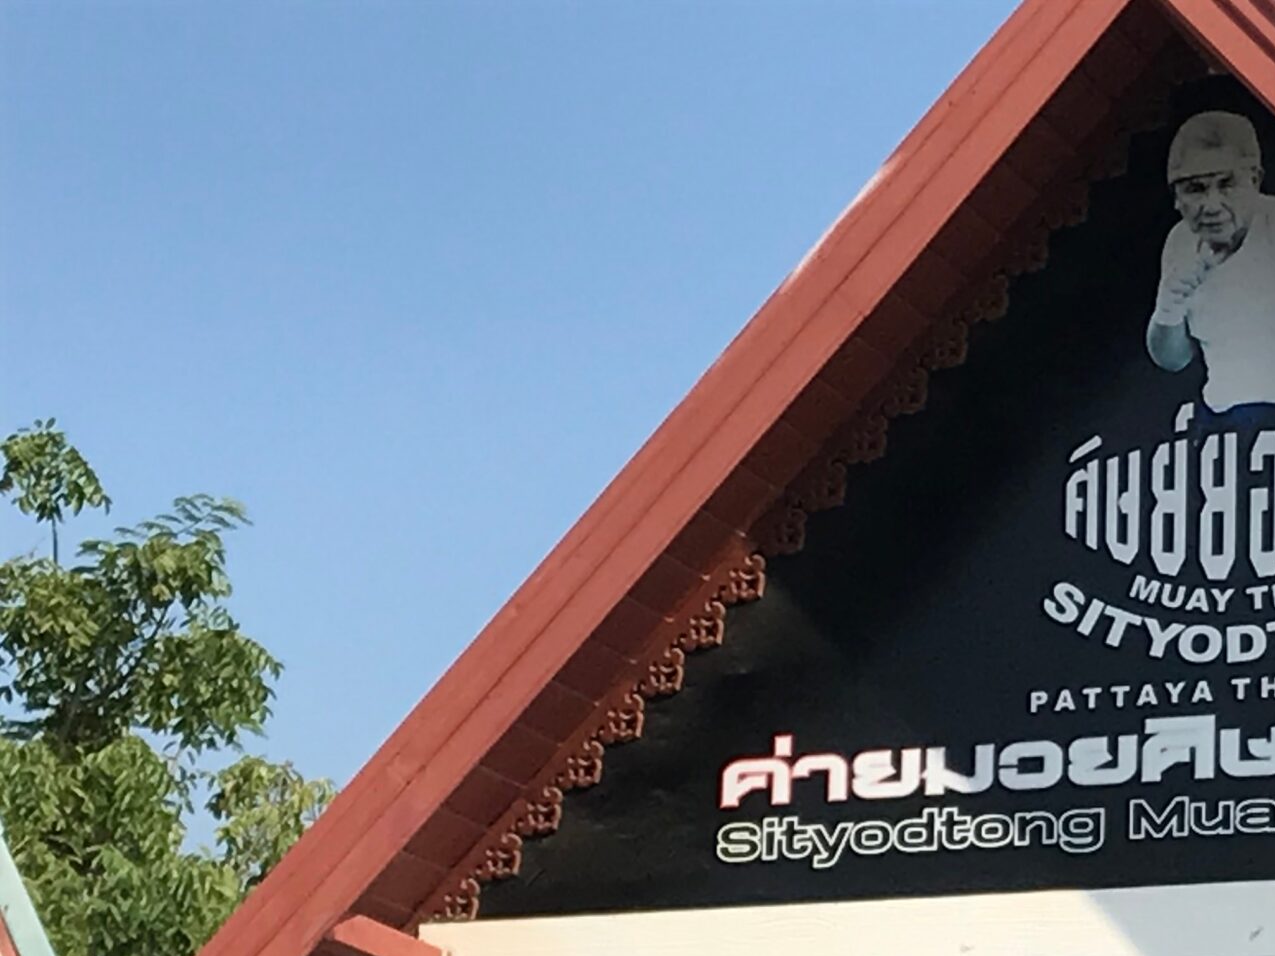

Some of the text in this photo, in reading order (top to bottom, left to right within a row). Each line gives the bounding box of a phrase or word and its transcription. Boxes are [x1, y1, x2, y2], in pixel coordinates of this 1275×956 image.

[1129, 574, 1235, 613] MUAY
[1030, 681, 1213, 713] PATTAYA
[716, 807, 1106, 869] Sityodtong
